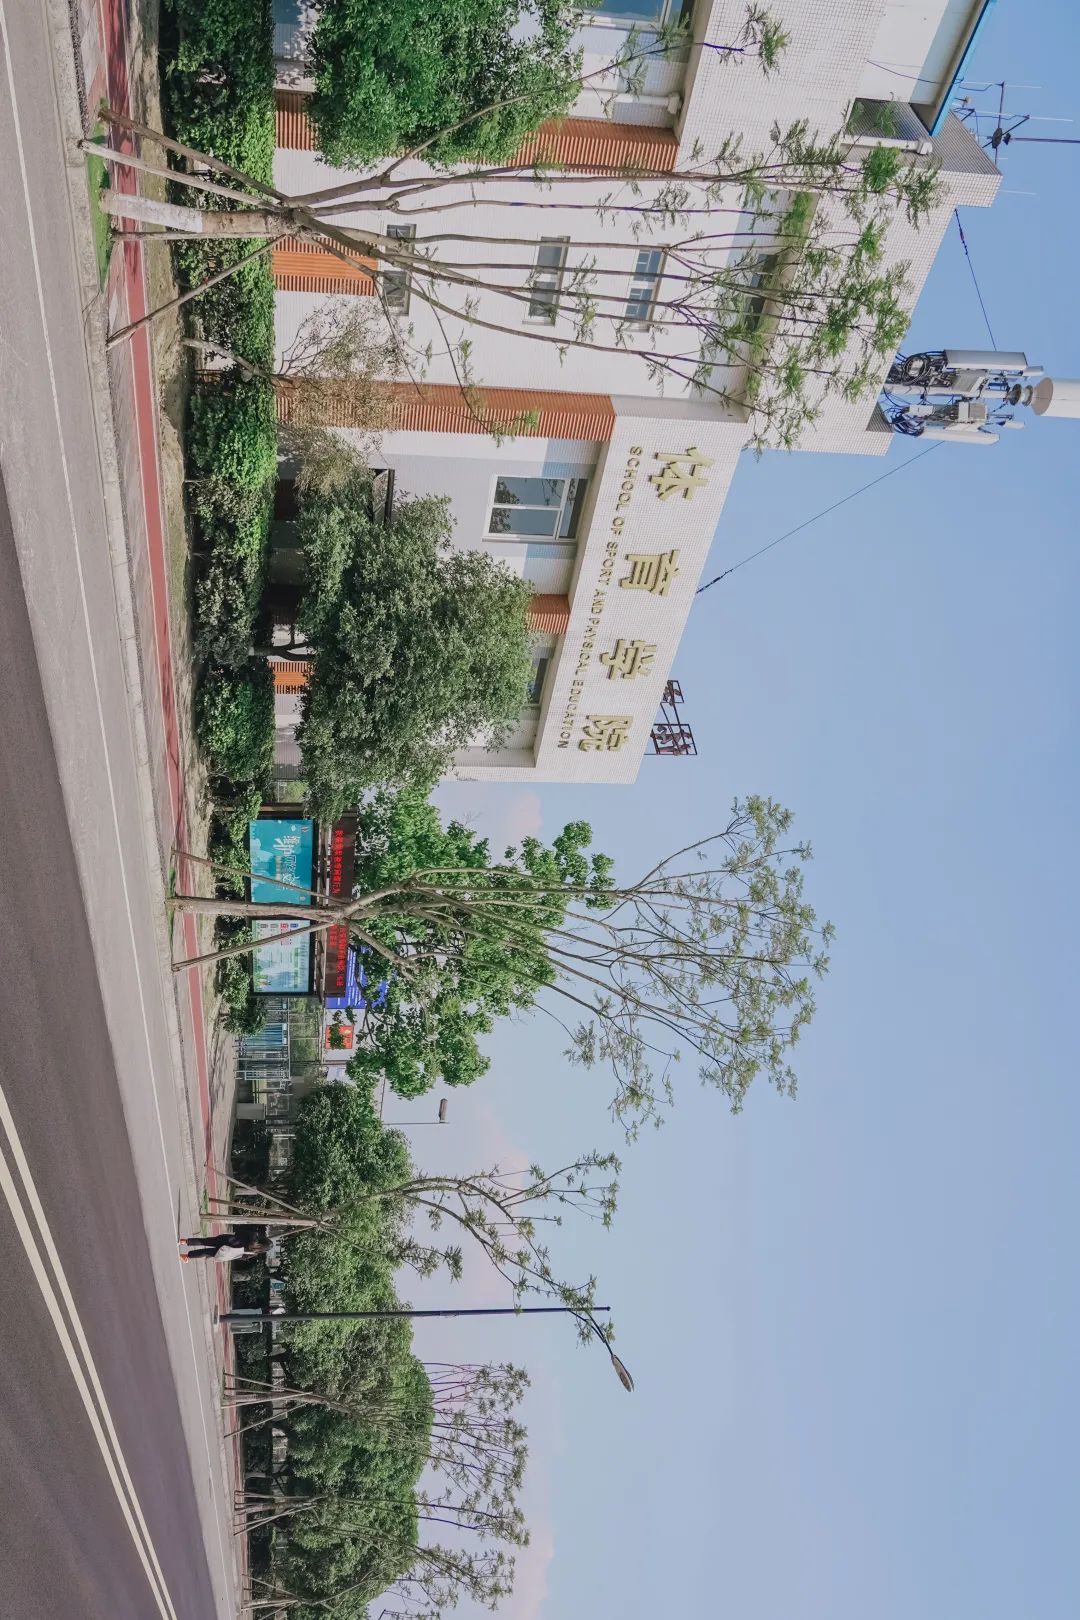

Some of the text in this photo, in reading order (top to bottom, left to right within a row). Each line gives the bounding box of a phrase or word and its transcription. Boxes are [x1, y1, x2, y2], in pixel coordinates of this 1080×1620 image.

[558, 446, 644, 748] SCHOOL OF SPORT AND PHYSICAL EDUCATION
[578, 447, 716, 752] 体育学院
